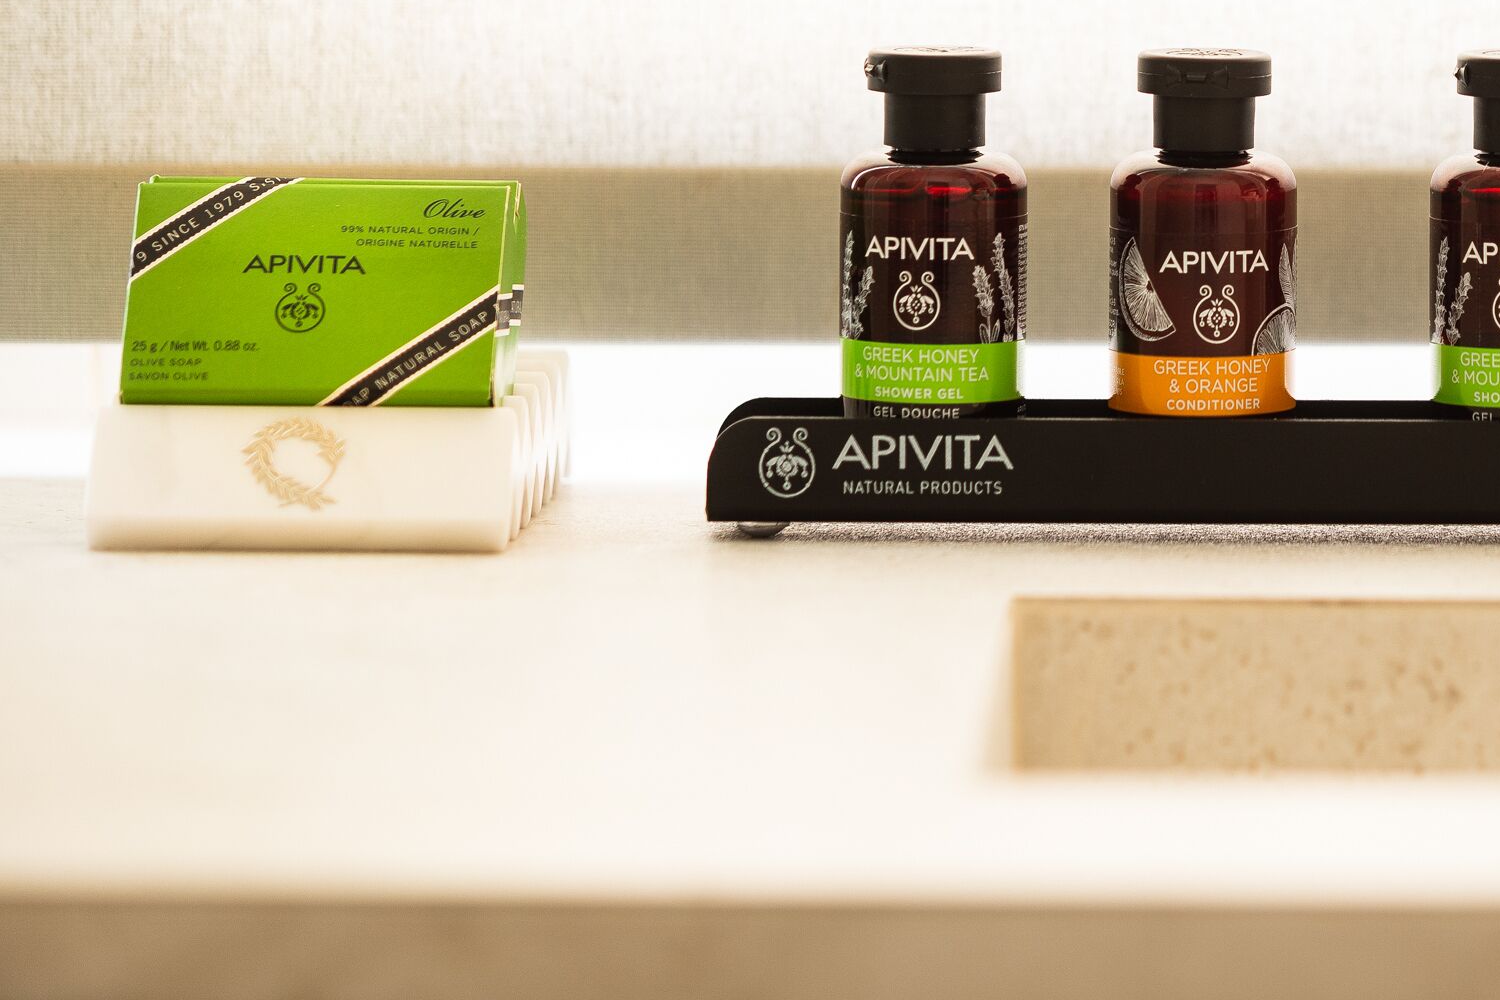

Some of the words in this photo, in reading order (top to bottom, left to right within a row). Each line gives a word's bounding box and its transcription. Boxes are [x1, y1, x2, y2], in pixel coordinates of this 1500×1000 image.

[423, 198, 485, 218] Olive
[151, 217, 200, 252] SINCE
[204, 190, 244, 218] 1979
[341, 225, 364, 233] 99%
[368, 226, 423, 235] NATURAL
[428, 226, 470, 235] ORIGIN
[356, 238, 405, 247] ORIGINE
[409, 239, 478, 249] NATURELLE
[865, 235, 975, 261] APIVITA
[242, 254, 366, 275] APIVITA
[1159, 249, 1270, 274] APIVITA
[132, 341, 147, 352] 25
[170, 341, 189, 351] Net
[375, 340, 447, 389] NATURAL
[448, 311, 488, 342] SOAP
[863, 346, 913, 363] GREEK
[919, 348, 980, 364] HONEY
[129, 358, 165, 367] OLIVE
[169, 358, 202, 367] SOAP
[1153, 359, 1210, 376] GREEK
[1216, 358, 1271, 375] HONEY
[128, 371, 169, 380] SAVON
[172, 372, 209, 380] OLIVE
[855, 363, 863, 378] &
[866, 364, 953, 382] MOUNTAIN
[959, 367, 990, 382] TEA
[1451, 369, 1460, 384] &
[874, 385, 932, 400] SHOWER
[938, 387, 964, 400] GEL
[1169, 379, 1180, 394] &
[1185, 377, 1258, 394] ORANGE
[873, 405, 897, 418] GEL
[901, 406, 960, 420] DOUCHE
[1166, 398, 1260, 411] CONDITIONER
[832, 434, 1014, 470] APIVITA
[843, 480, 915, 495] NATURAL
[920, 480, 1003, 495] PRODUCTS
